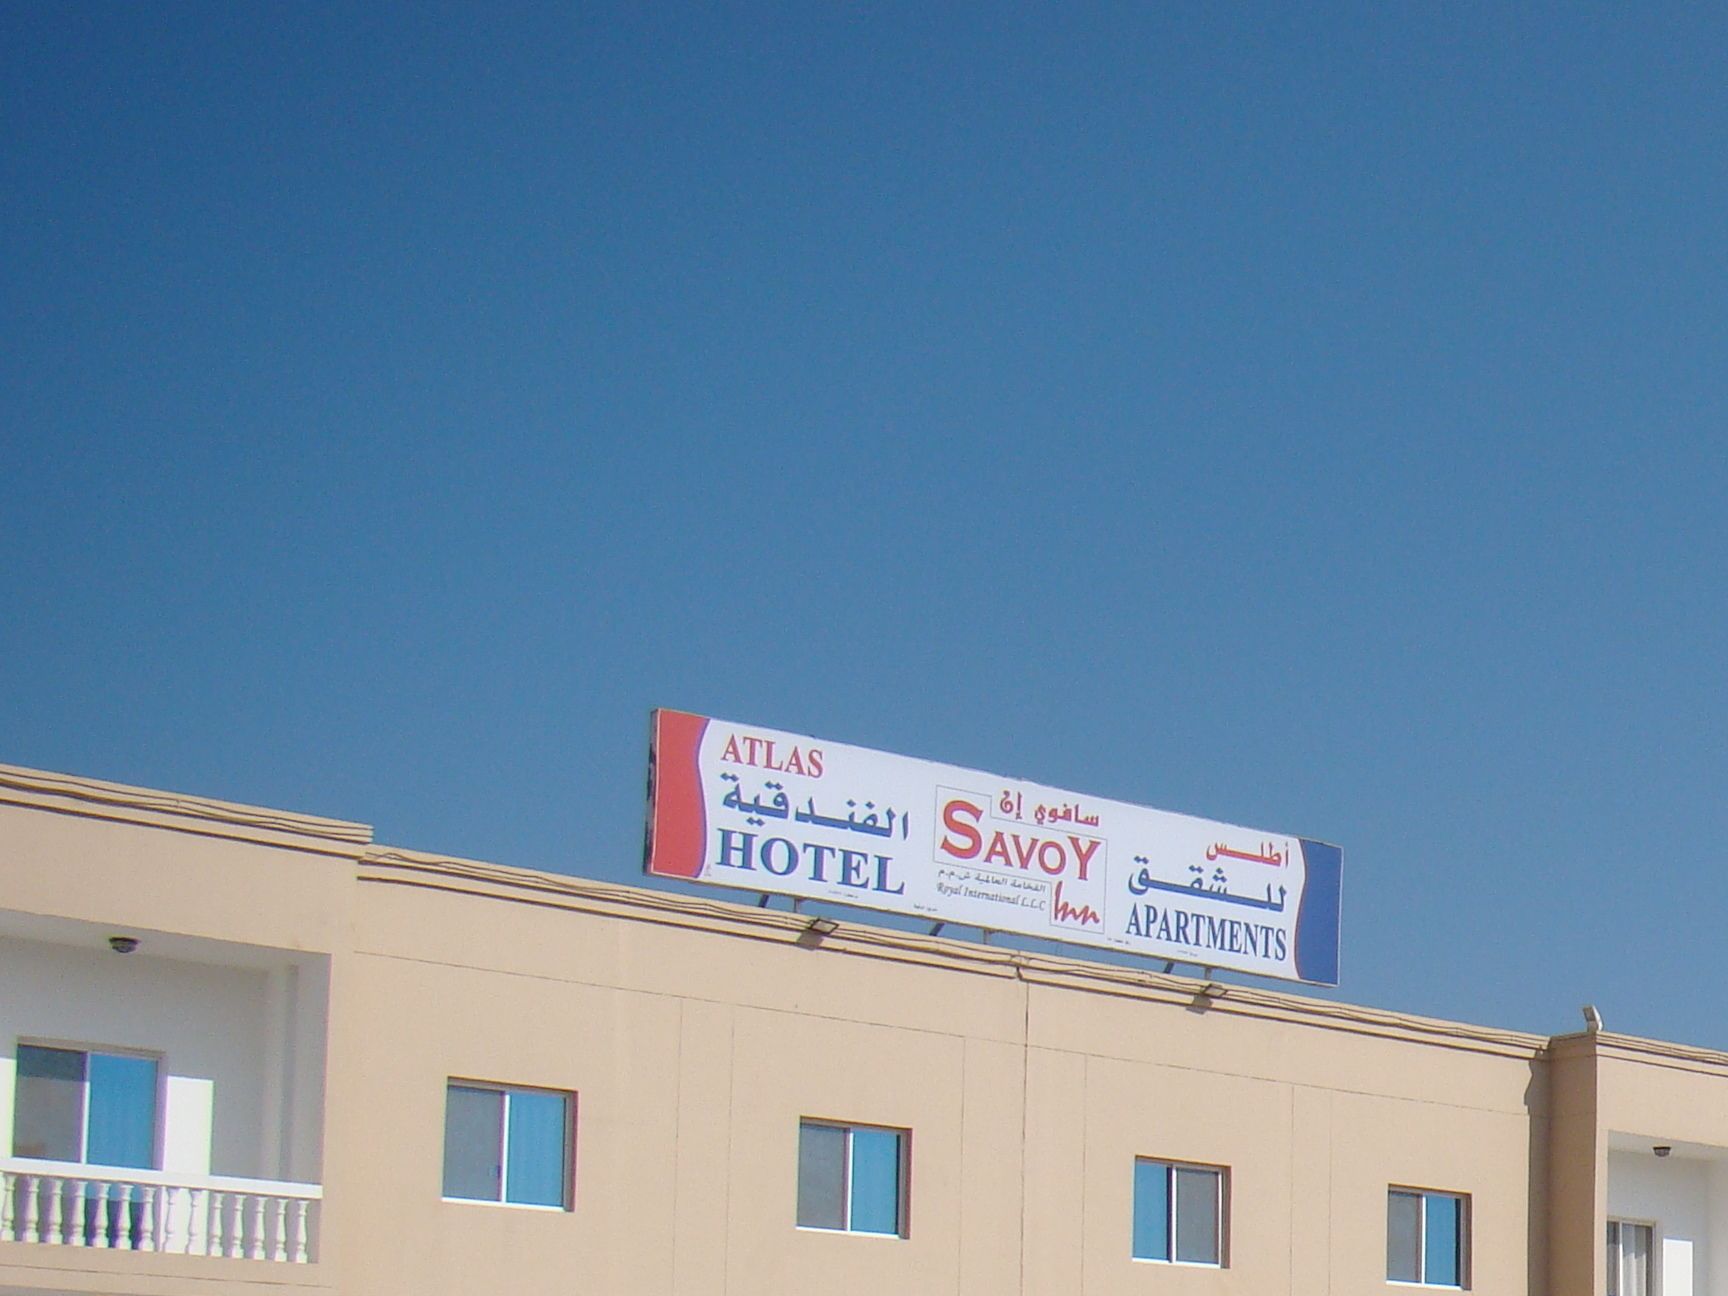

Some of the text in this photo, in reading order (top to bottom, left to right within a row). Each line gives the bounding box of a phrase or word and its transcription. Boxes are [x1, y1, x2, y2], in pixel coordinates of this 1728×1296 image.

[720, 734, 824, 779] ATLAS
[720, 772, 910, 841] الفندقية
[1034, 803, 1099, 827] سافوي
[716, 828, 906, 896] HOTEL
[940, 799, 1102, 881] SAVOY
[937, 882, 963, 897] Royal
[1054, 881, 1100, 926] Inn
[1128, 855, 1288, 912] للشقق
[1125, 902, 1287, 961] APARTMENTS
